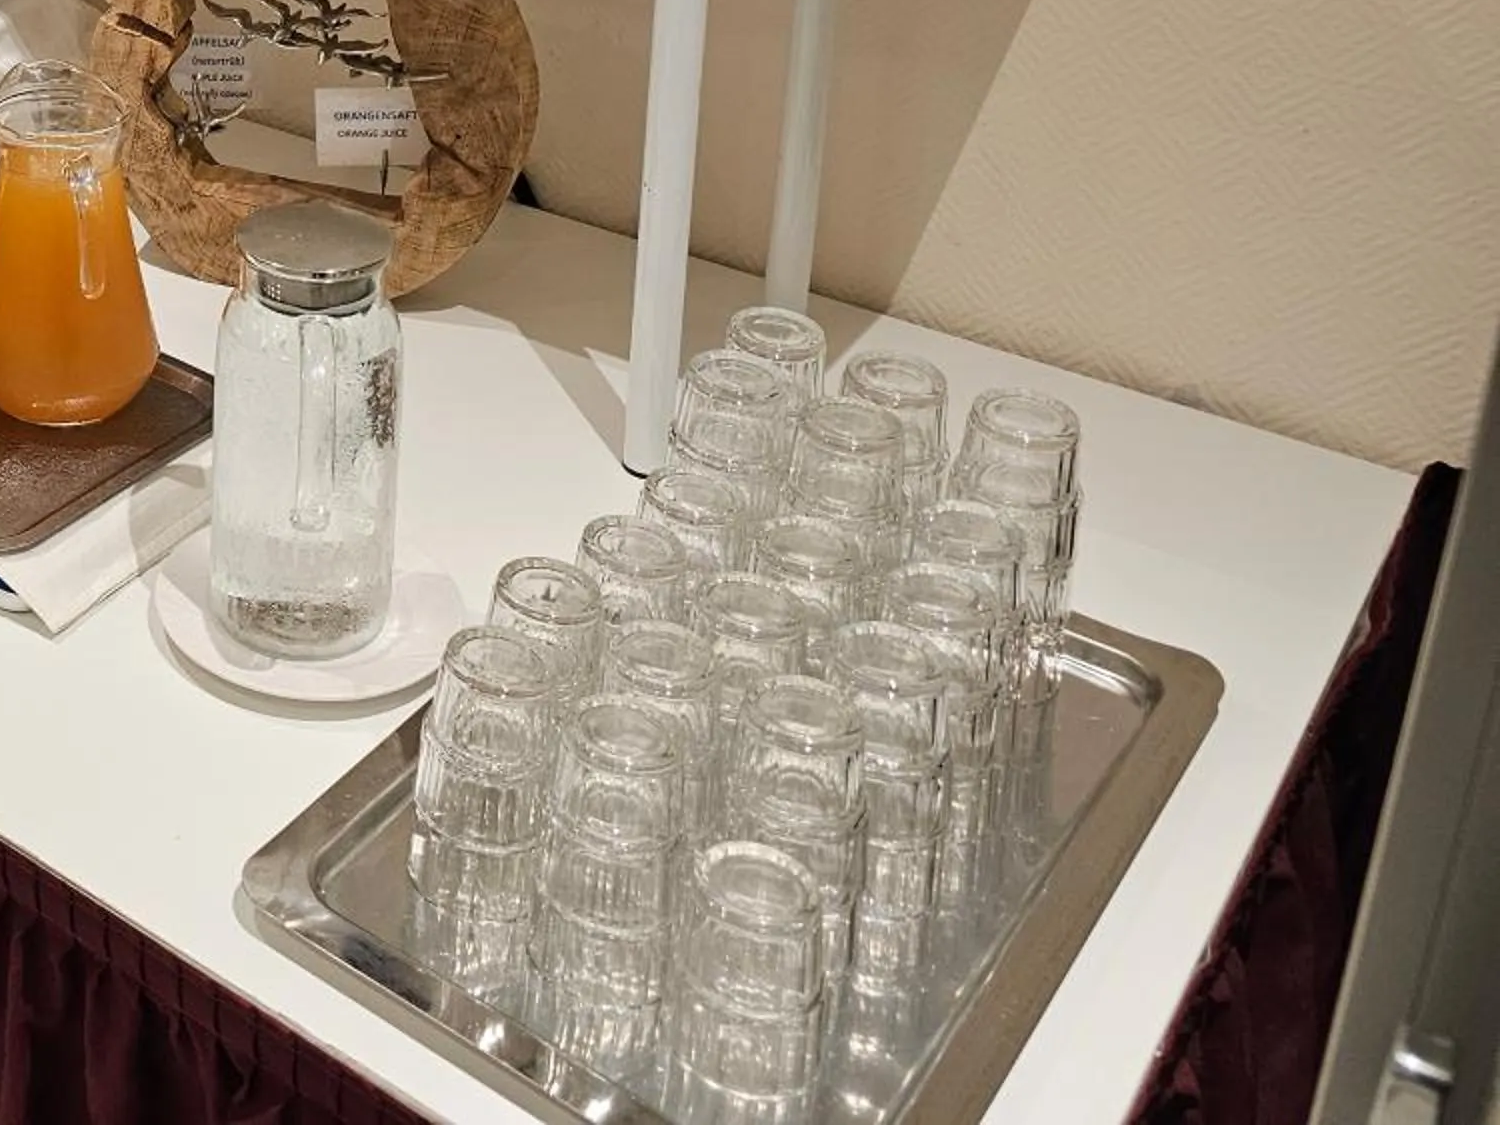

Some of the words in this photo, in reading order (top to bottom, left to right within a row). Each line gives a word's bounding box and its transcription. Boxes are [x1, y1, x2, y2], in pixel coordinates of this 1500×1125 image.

[333, 110, 418, 121] ORANGENSAFT
[336, 129, 379, 139] ORANGE
[380, 128, 408, 138] JUICE
